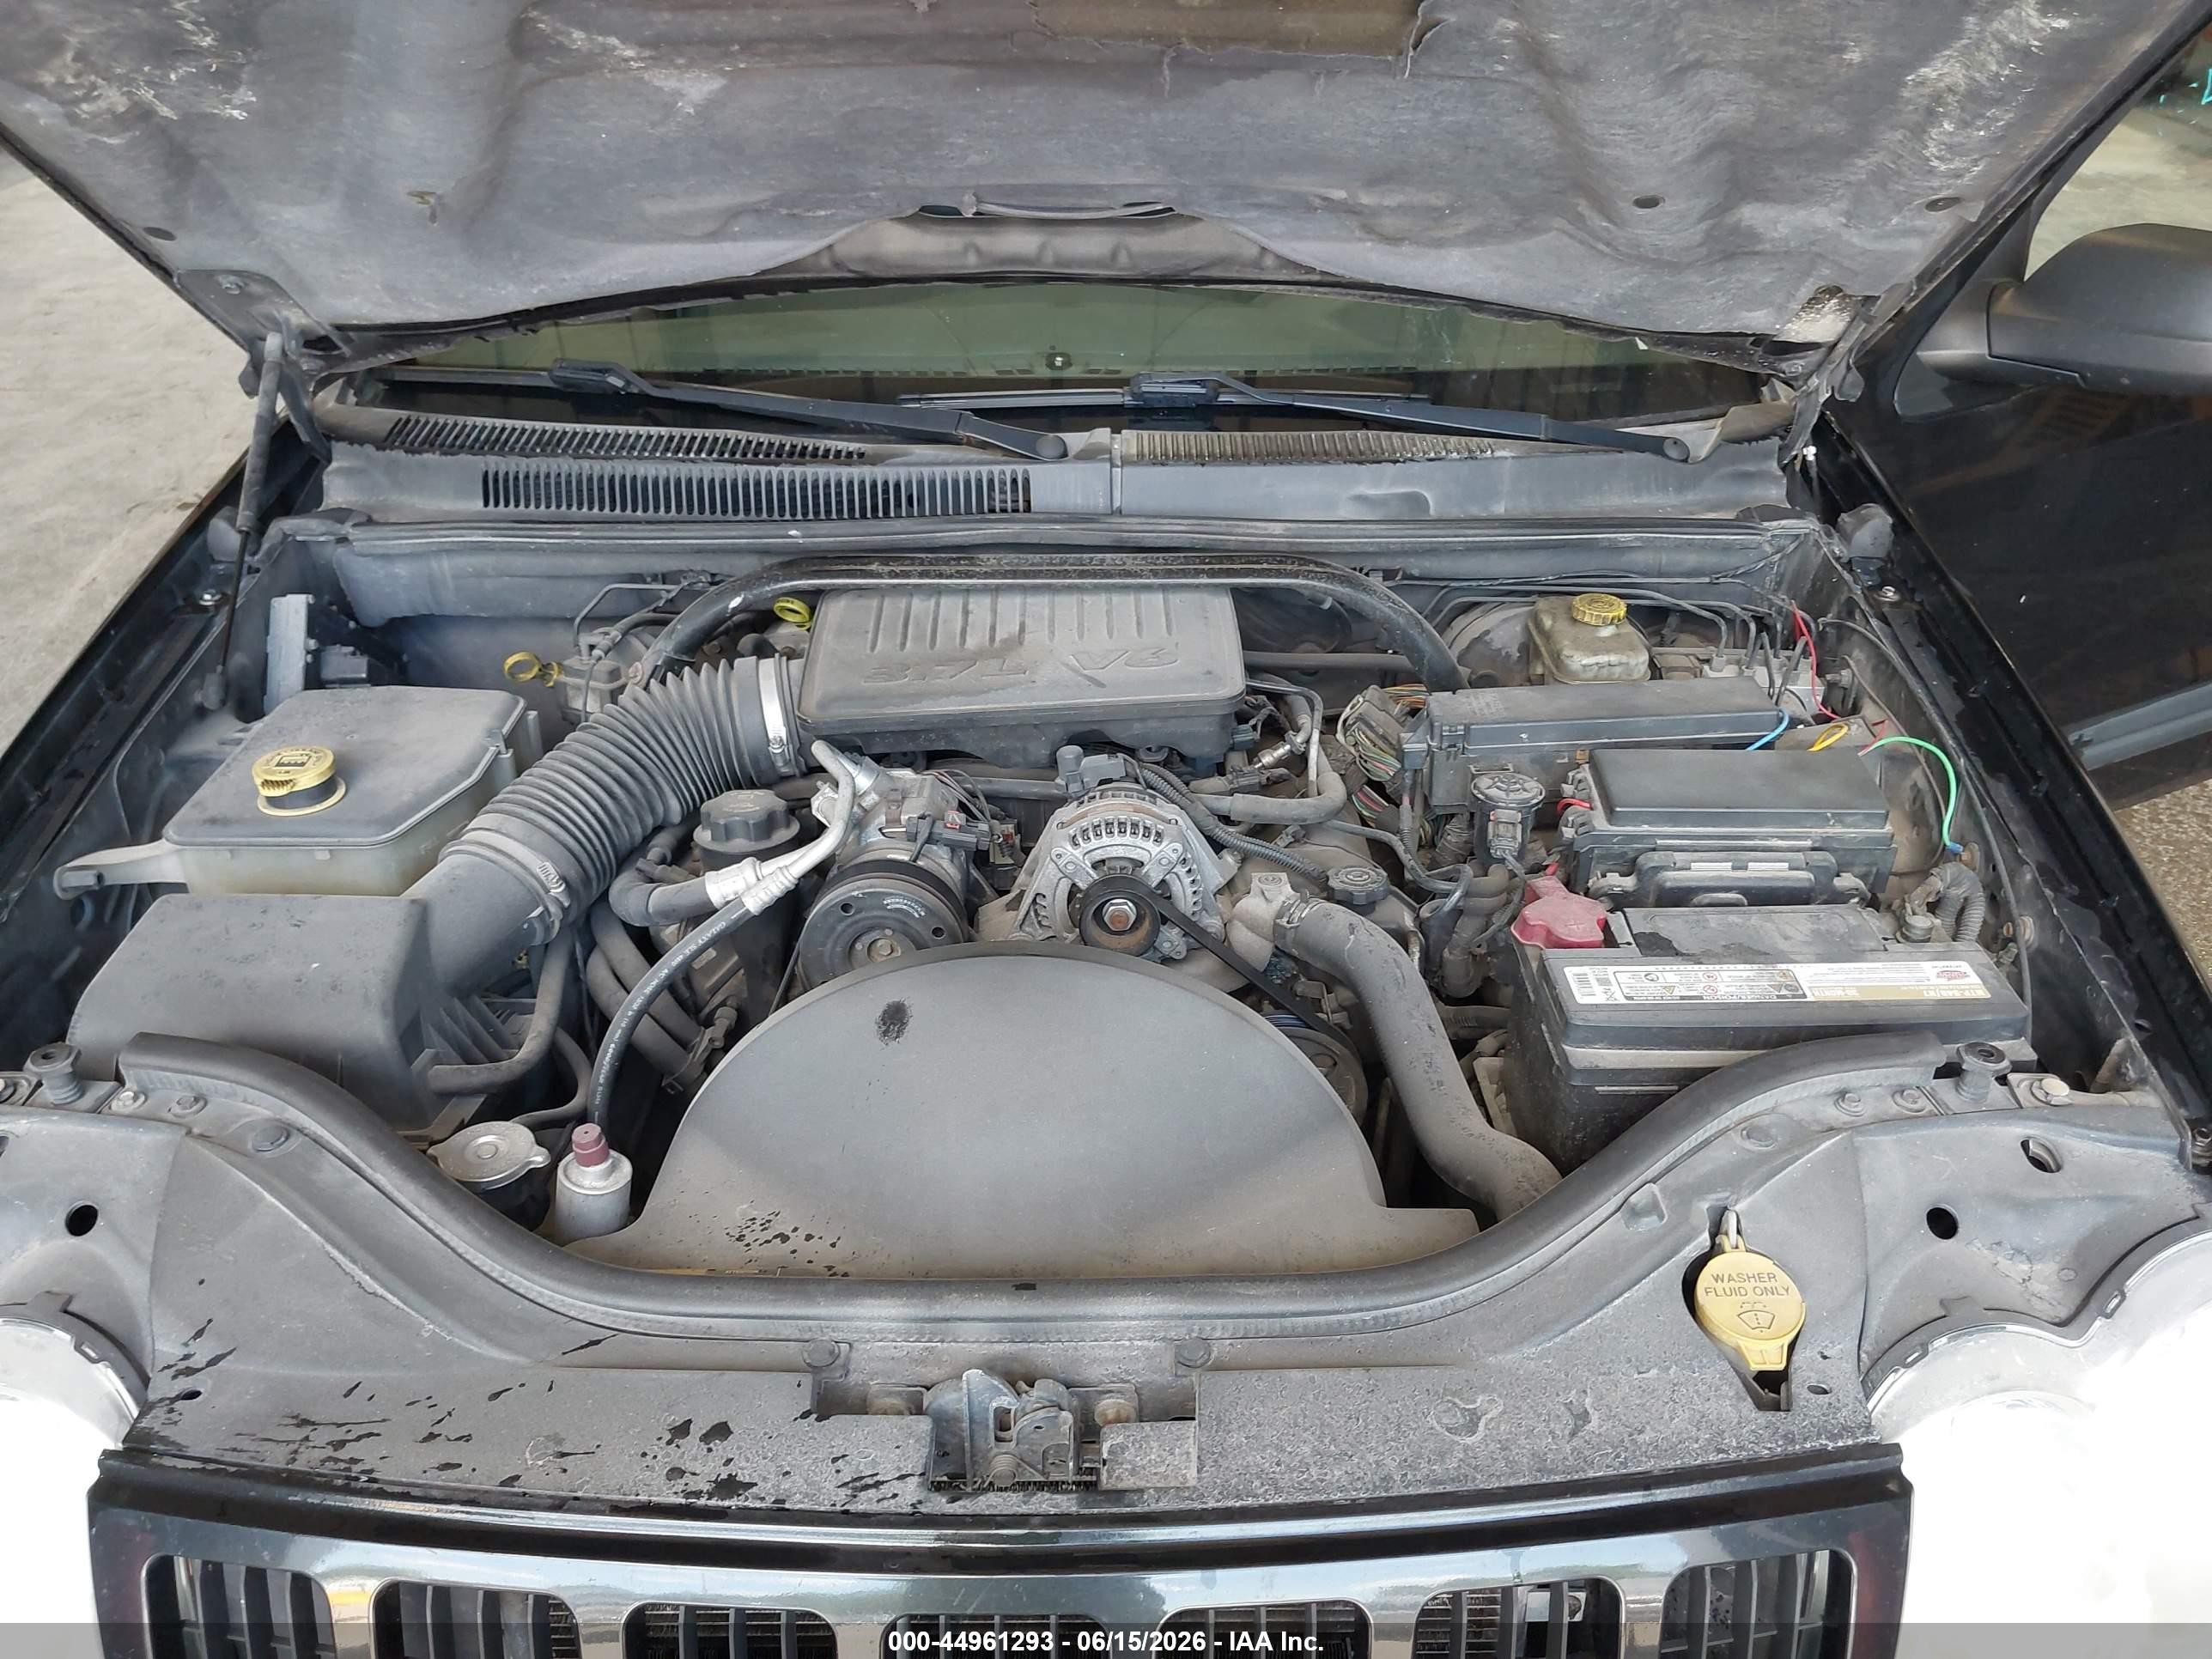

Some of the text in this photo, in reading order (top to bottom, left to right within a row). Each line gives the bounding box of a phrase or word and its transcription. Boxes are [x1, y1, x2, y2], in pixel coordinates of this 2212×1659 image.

[862, 646, 1180, 685] 3.7L V6
[1711, 1272, 1778, 1284] WASHER
[1705, 1285, 1790, 1297] FLUID ONLY
